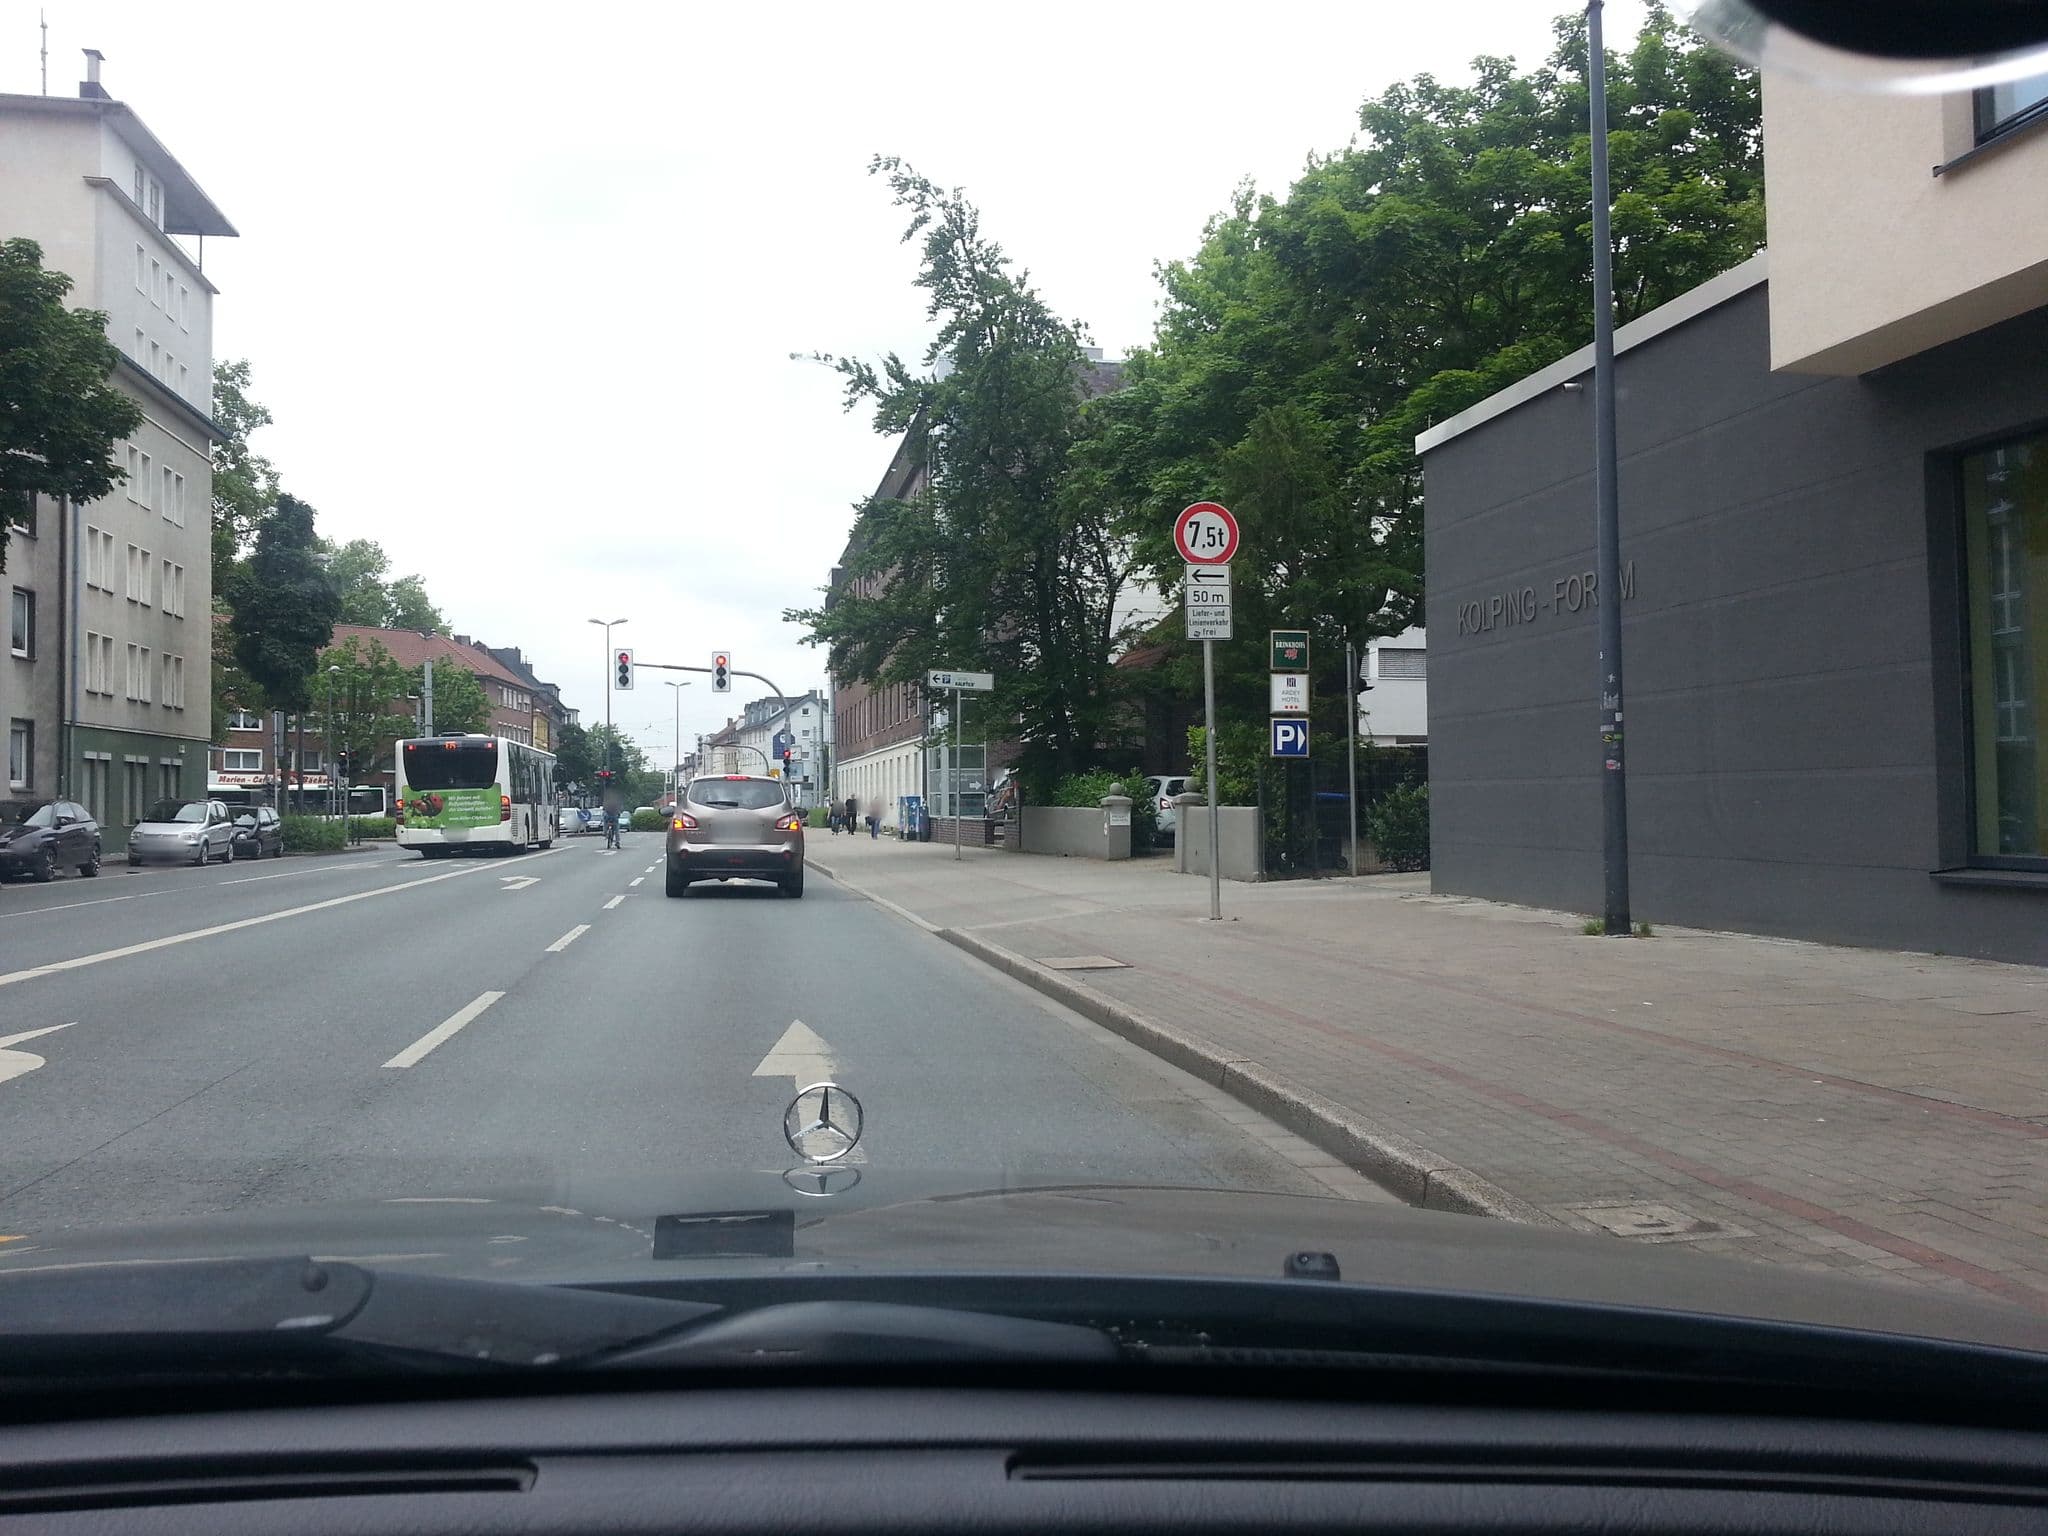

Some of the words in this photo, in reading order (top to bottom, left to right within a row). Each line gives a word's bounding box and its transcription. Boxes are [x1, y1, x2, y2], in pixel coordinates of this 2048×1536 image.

[1188, 521, 1225, 549] 7,5t
[1193, 590, 1209, 603] 50
[1212, 593, 1224, 603] m
[1457, 585, 1537, 637] KOLPING
[1552, 559, 1636, 616] FORM
[1192, 609, 1213, 617] Liefer-
[1215, 609, 1225, 617] und
[1189, 617, 1229, 626] Linienverkehr
[1202, 627, 1217, 636] frei
[1277, 725, 1295, 751] P
[218, 775, 246, 784] Marien
